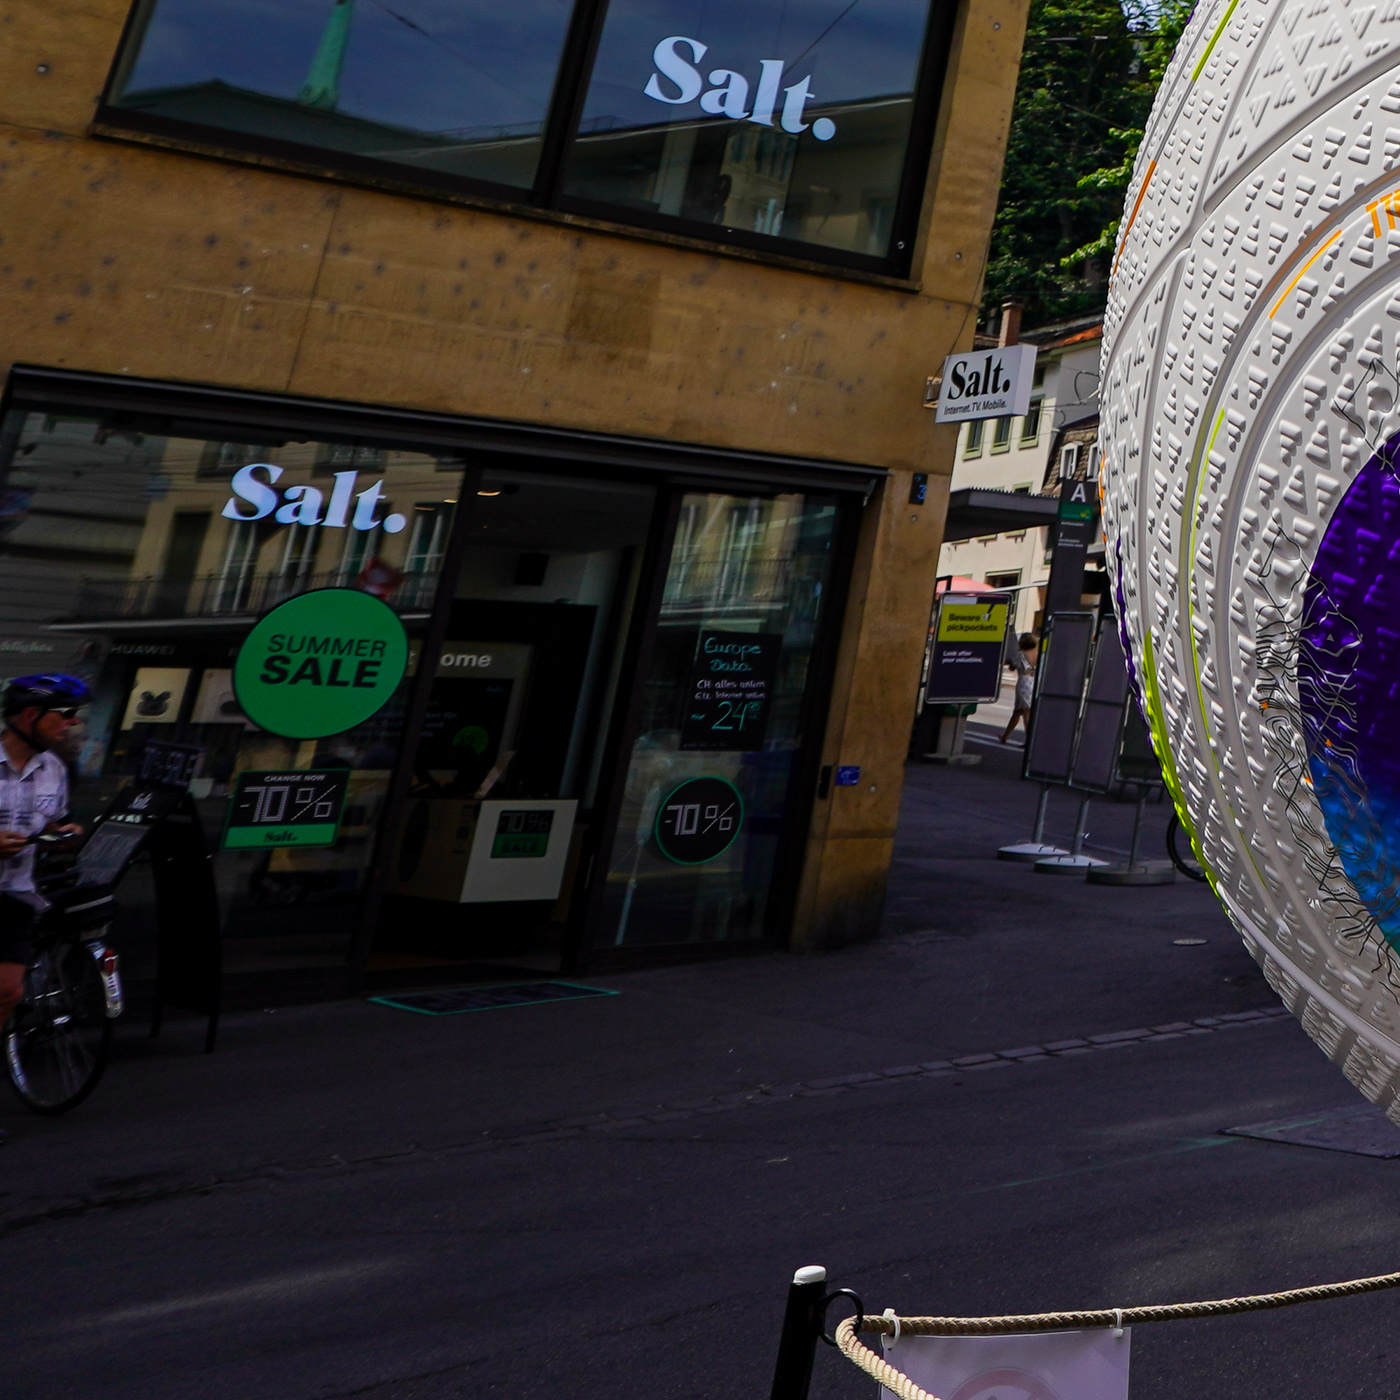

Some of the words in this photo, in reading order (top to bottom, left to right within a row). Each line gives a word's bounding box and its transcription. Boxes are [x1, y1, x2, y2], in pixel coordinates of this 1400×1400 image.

[643, 36, 837, 142] Salt.
[947, 355, 1010, 400] Salt.
[221, 463, 407, 533] Salt.
[1071, 483, 1086, 502] A
[947, 624, 997, 632] pickpockets
[949, 613, 980, 621] Beware
[267, 634, 386, 658] SUMMER
[704, 637, 763, 660] Europe
[261, 655, 382, 689] SALE
[709, 659, 752, 671] Data
[264, 774, 302, 782] CHANGE
